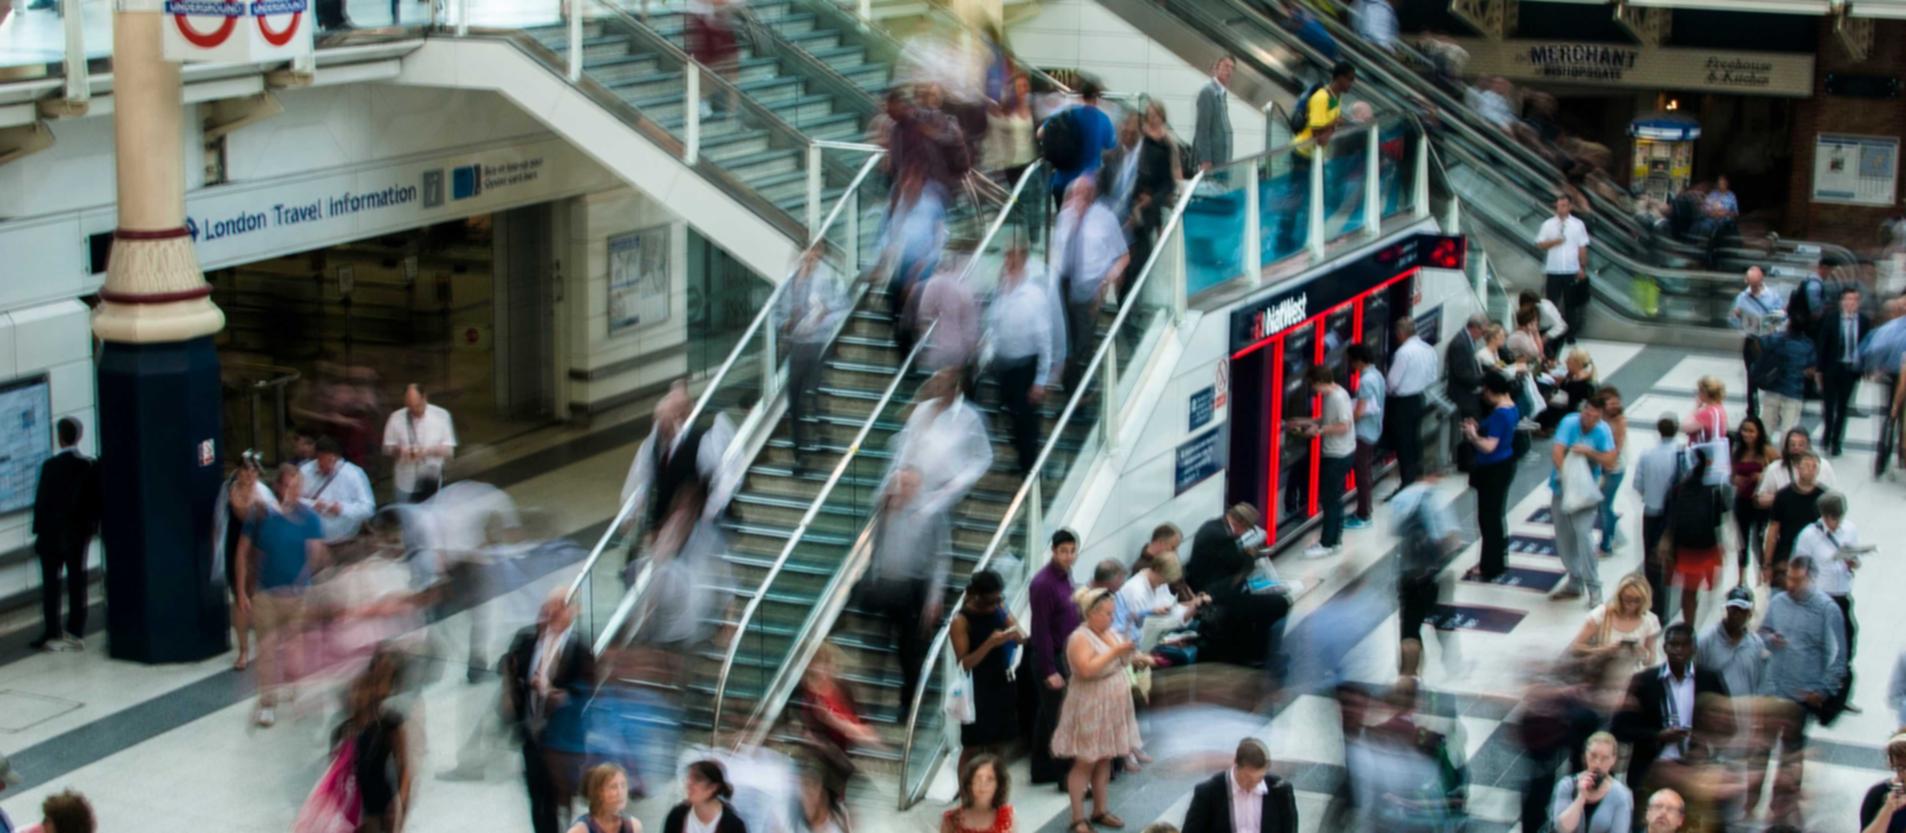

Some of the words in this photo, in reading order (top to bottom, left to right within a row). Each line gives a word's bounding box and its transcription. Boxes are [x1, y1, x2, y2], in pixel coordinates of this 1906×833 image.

[169, 1, 241, 14] UNDERGROUND
[1530, 44, 1639, 68] MERCHANT
[205, 211, 267, 240] London
[274, 199, 322, 226] Travel
[329, 184, 417, 217] Information
[1266, 291, 1307, 336] NatWest
